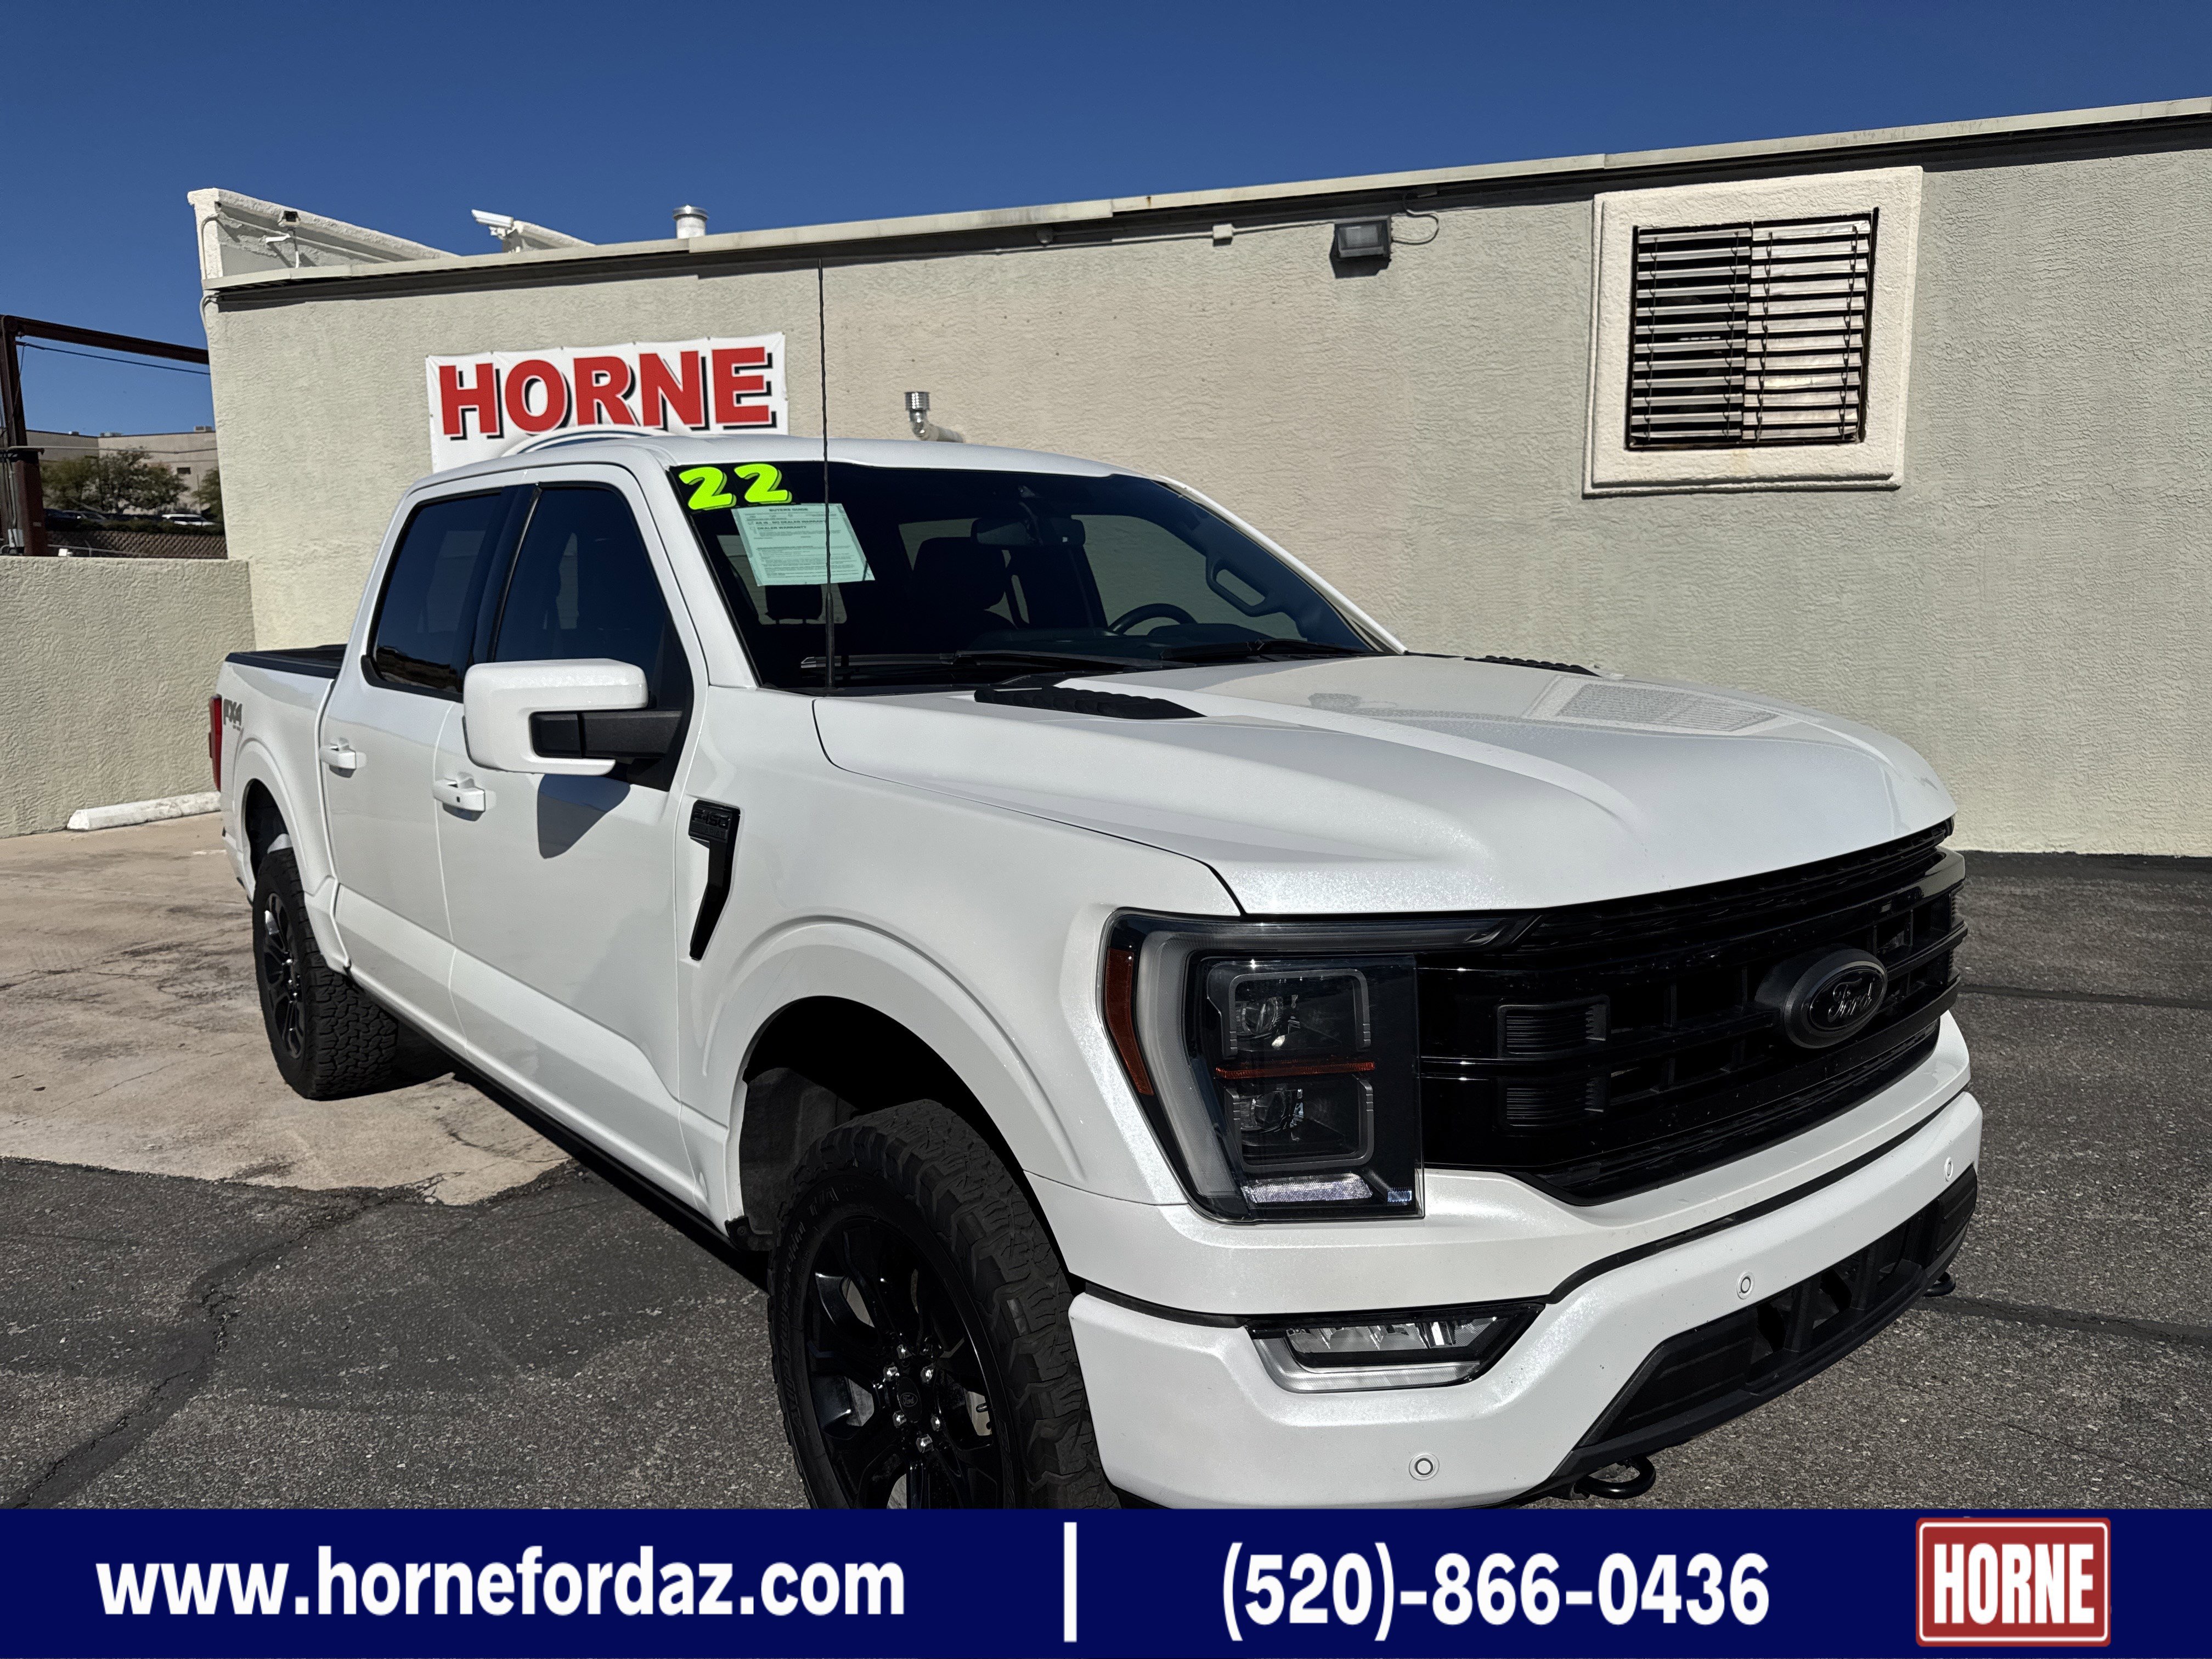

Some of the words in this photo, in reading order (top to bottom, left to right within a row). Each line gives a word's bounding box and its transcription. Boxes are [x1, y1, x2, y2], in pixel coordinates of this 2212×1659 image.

[439, 347, 775, 440] HORNE
[679, 464, 792, 510] 22
[1827, 978, 1876, 1023] Ford
